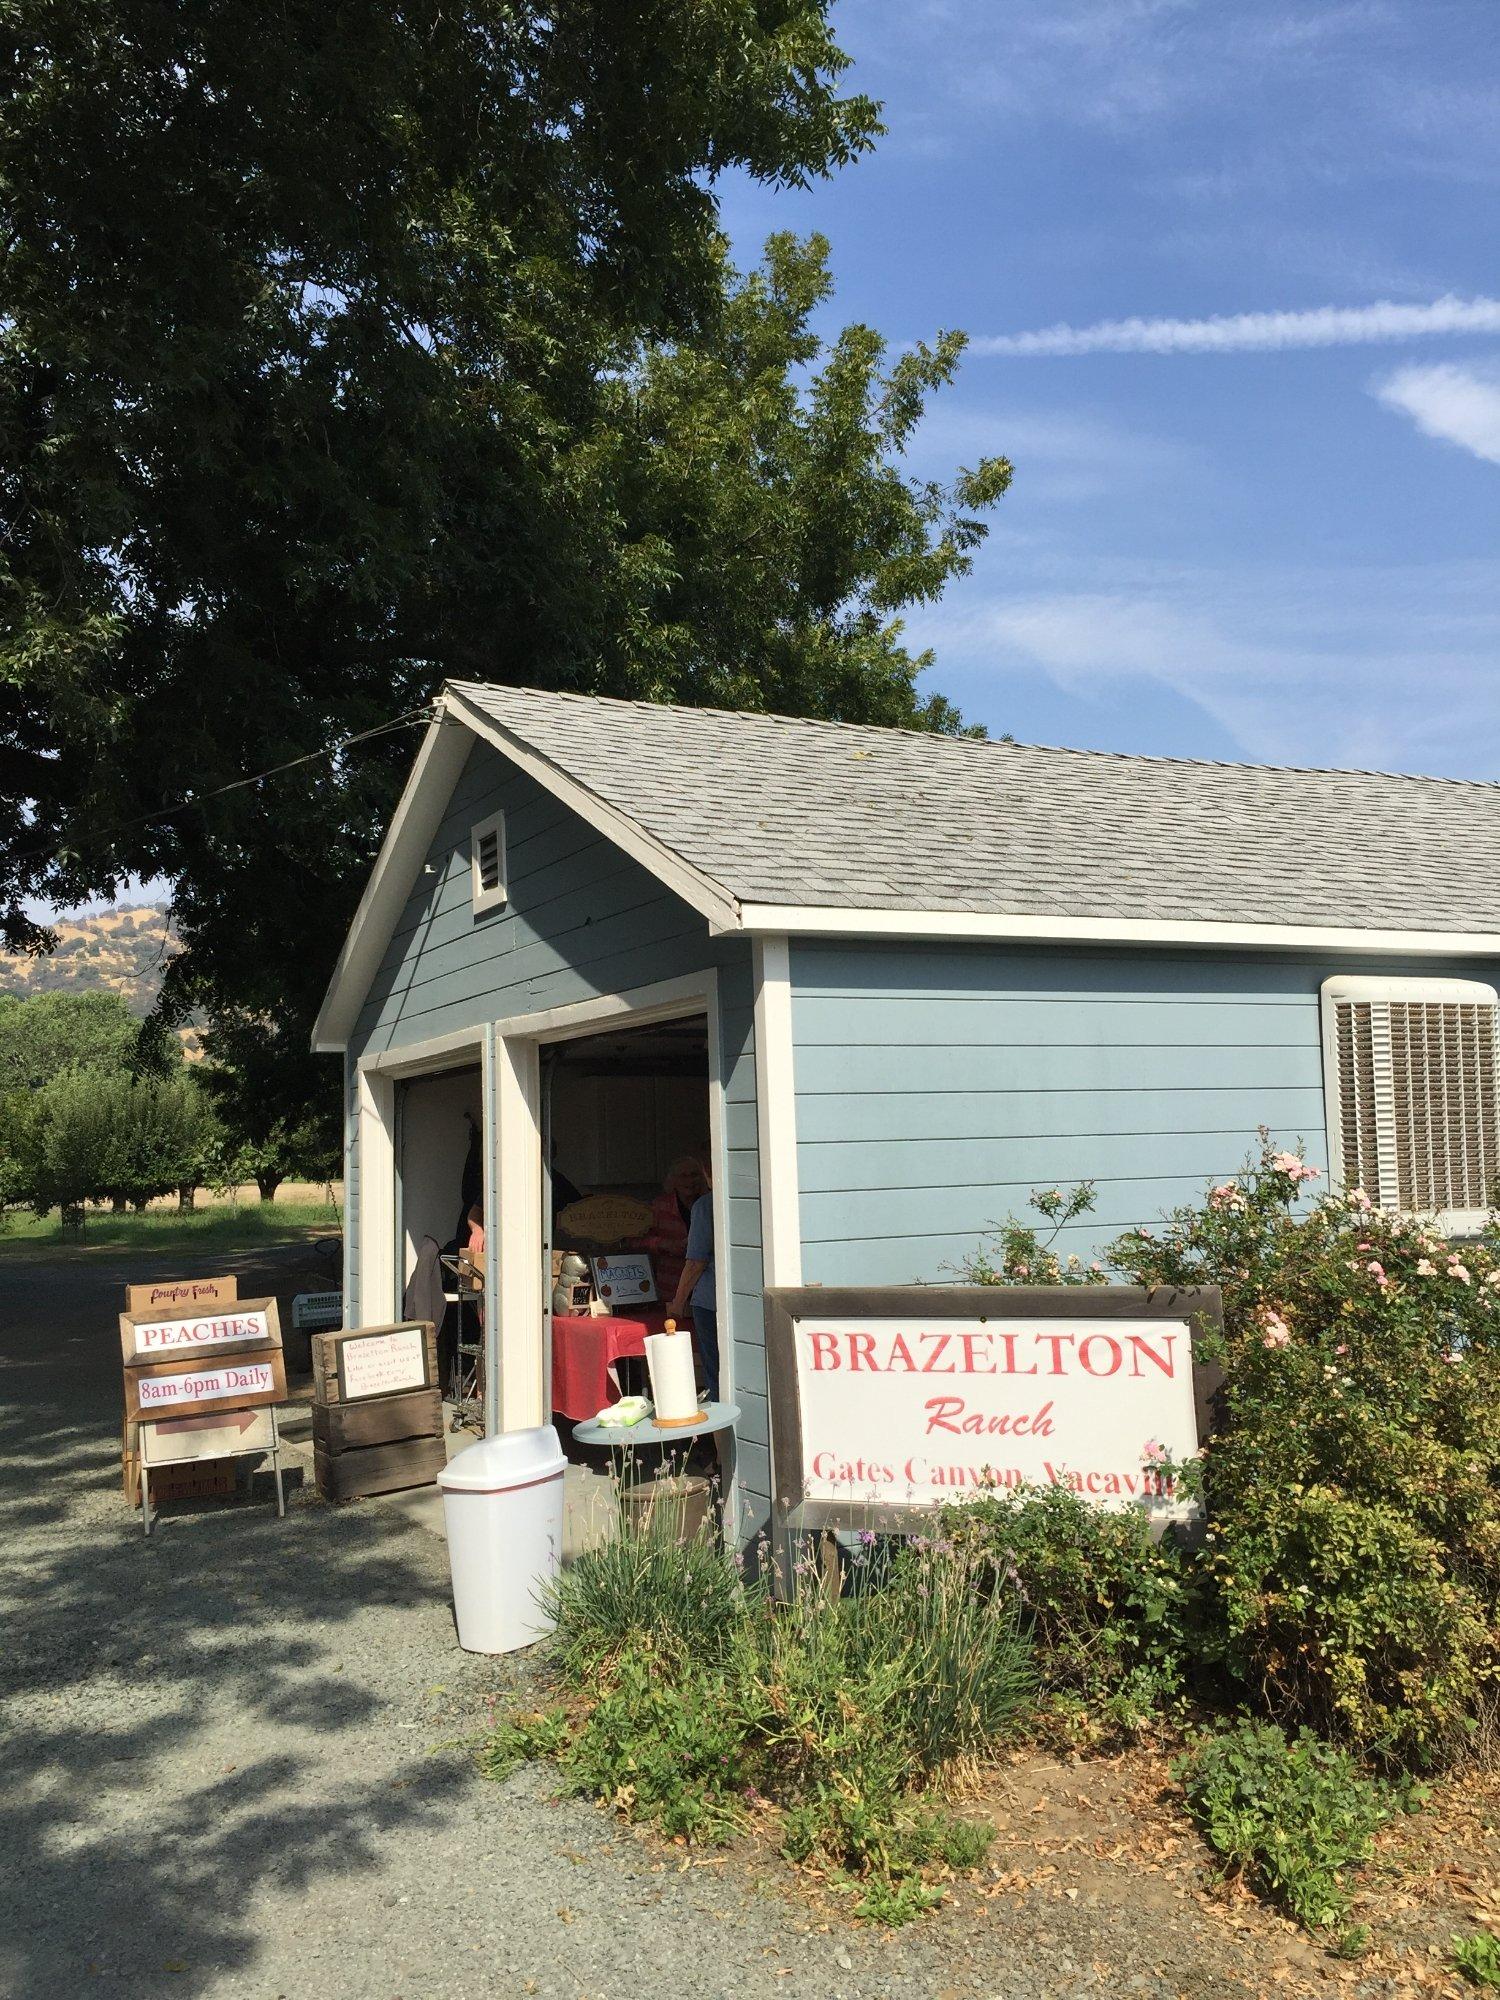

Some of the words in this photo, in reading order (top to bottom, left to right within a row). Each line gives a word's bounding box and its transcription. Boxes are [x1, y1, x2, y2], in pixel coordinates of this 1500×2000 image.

[600, 1266, 647, 1281] MAGNETS
[152, 1286, 190, 1299] Country
[192, 1284, 216, 1295] Fresh
[143, 1317, 260, 1347] PEACHES
[349, 1339, 385, 1351] Welcome
[390, 1342, 417, 1353] Ranch
[806, 1332, 1178, 1379] BRAZELTON
[141, 1376, 221, 1399] 8am-6pm
[225, 1367, 269, 1390] Daily
[923, 1395, 1057, 1437] Ranch
[812, 1451, 895, 1483] Gates
[1042, 1462, 1175, 1497] Vacavill
